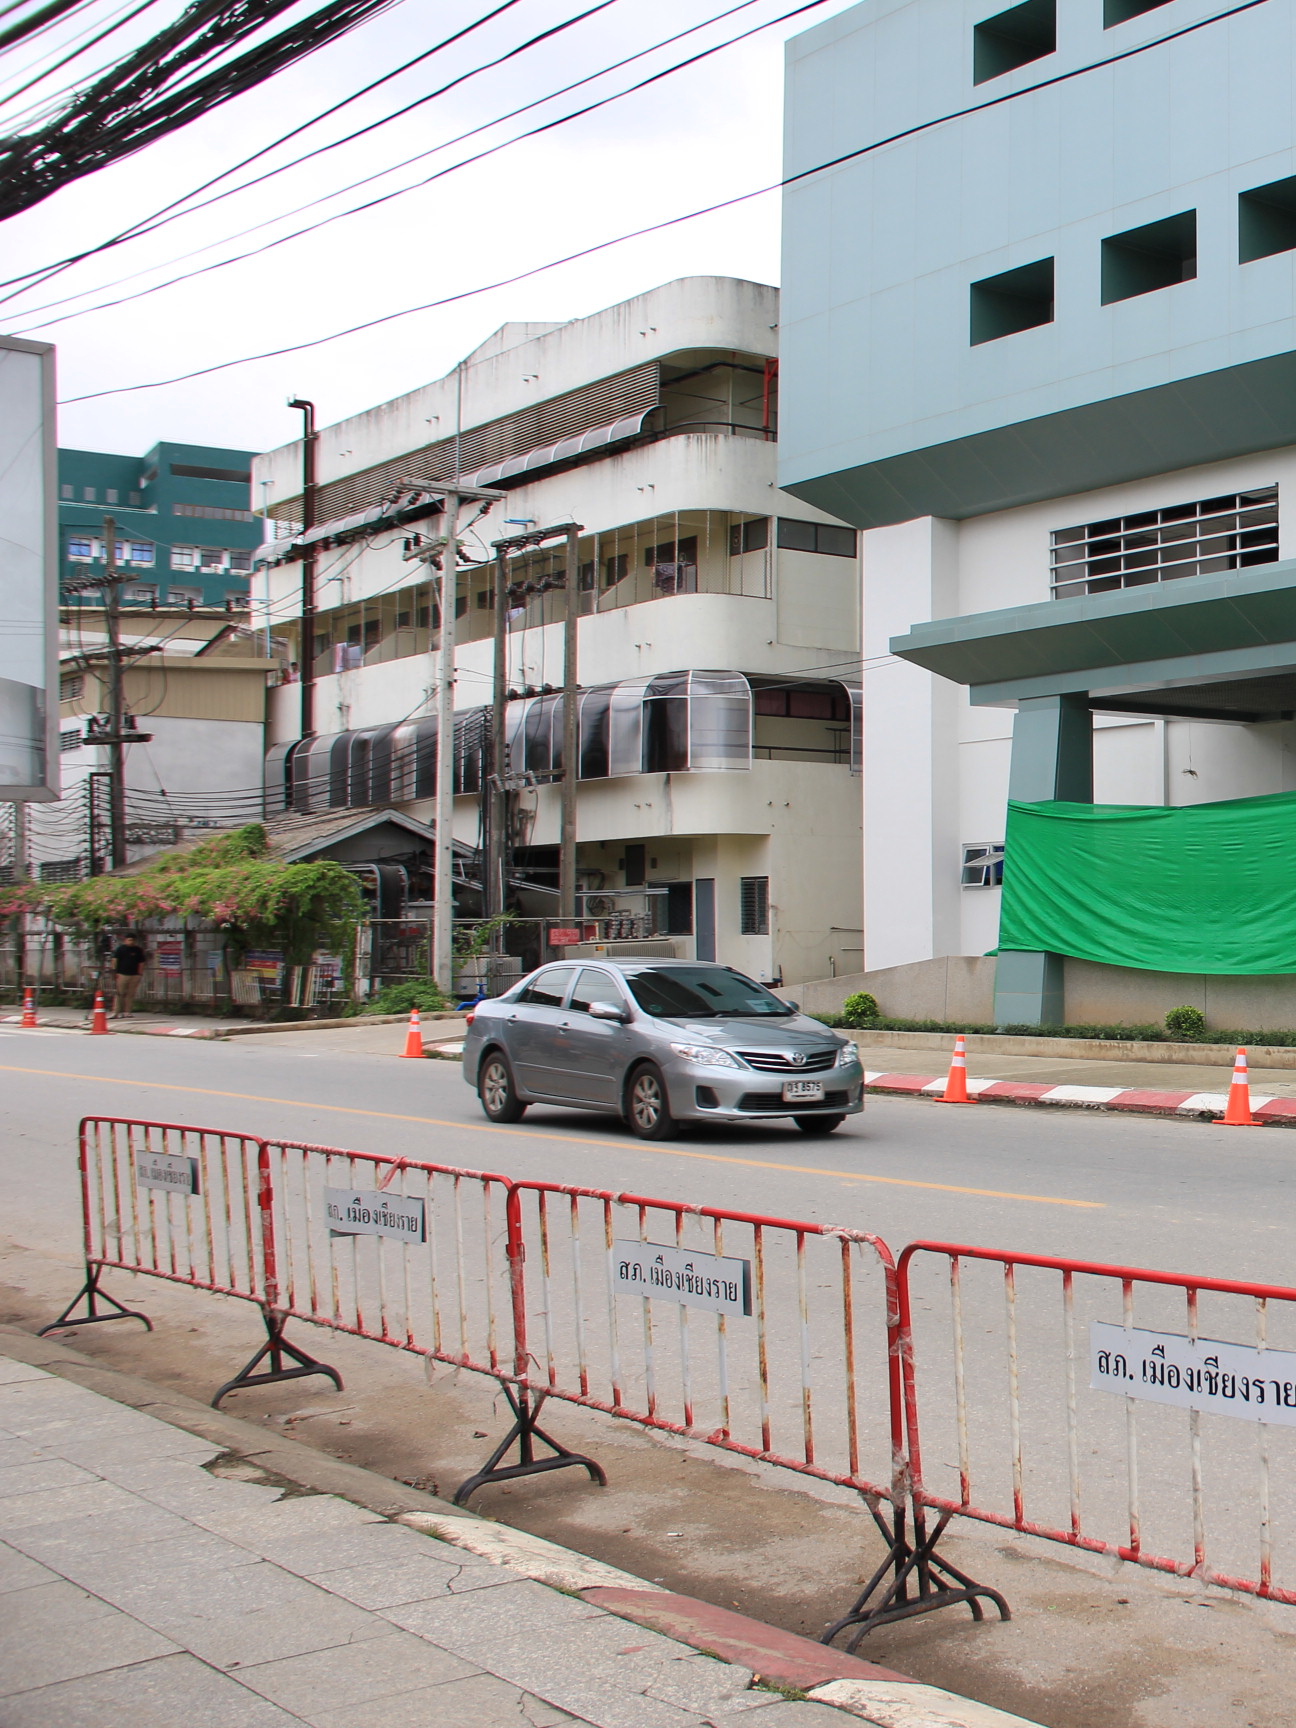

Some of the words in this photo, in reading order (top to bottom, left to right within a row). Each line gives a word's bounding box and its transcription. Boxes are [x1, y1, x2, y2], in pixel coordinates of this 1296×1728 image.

[619, 1260, 647, 1284] สภ.
[650, 1254, 738, 1302] เมืองเชียงราย
[1097, 1349, 1135, 1381] สภ.
